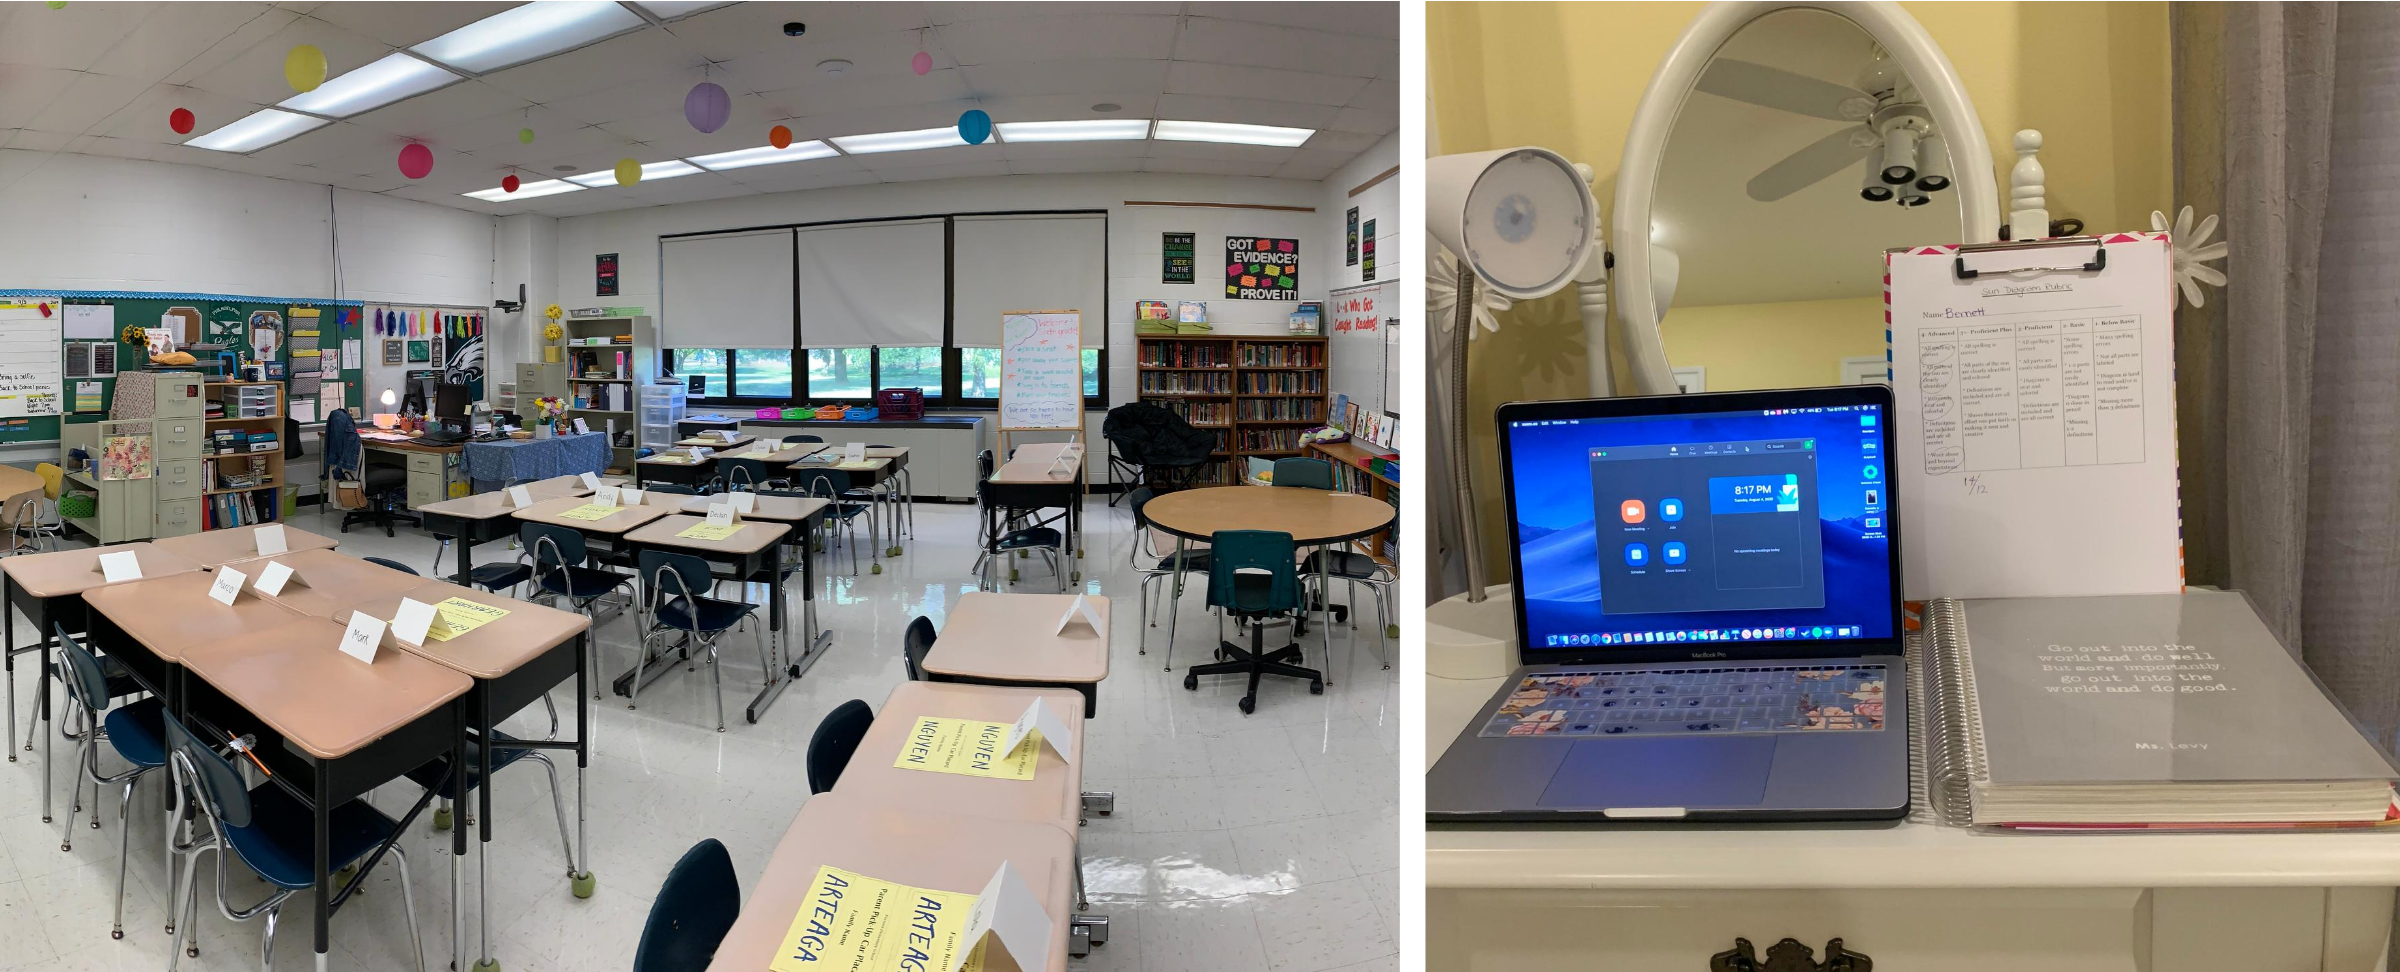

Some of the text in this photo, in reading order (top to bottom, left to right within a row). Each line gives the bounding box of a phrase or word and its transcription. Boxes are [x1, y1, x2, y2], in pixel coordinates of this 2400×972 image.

[1227, 239, 1254, 250] GOT
[1234, 252, 1298, 264] EVIDENCE?
[1241, 289, 1297, 300] PROVE IT!
[2004, 285, 2041, 297] Diagram
[1349, 299, 1360, 312] Who
[1363, 297, 1373, 312] Got
[1039, 319, 1068, 327] Welcome
[1334, 315, 1378, 334] Caught Reading!
[1734, 485, 1772, 495] 8:17 PM
[597, 490, 614, 506] Andy
[217, 578, 234, 594] Marco
[2048, 643, 2196, 652] Go out into the
[2037, 652, 2216, 662] world and do well
[2043, 664, 2071, 672] But
[2075, 664, 2115, 672] more
[2060, 673, 2213, 683] go out into the
[2044, 683, 2237, 694] world and do good.
[956, 723, 965, 734] Parent
[906, 720, 940, 764] NGUYEN
[971, 725, 1002, 771] NGUYEN
[2135, 742, 2209, 750] Ms. Levy
[943, 754, 954, 768] Placard
[874, 888, 888, 911] Parent
[793, 873, 849, 963] ARTEAGA
[865, 911, 881, 938] Pick-Up
[839, 909, 859, 946] Family Name
[899, 896, 942, 972] ARTEAG
[859, 939, 870, 956] Car
[941, 931, 956, 972] Family Name
[850, 955, 864, 972] Plac
